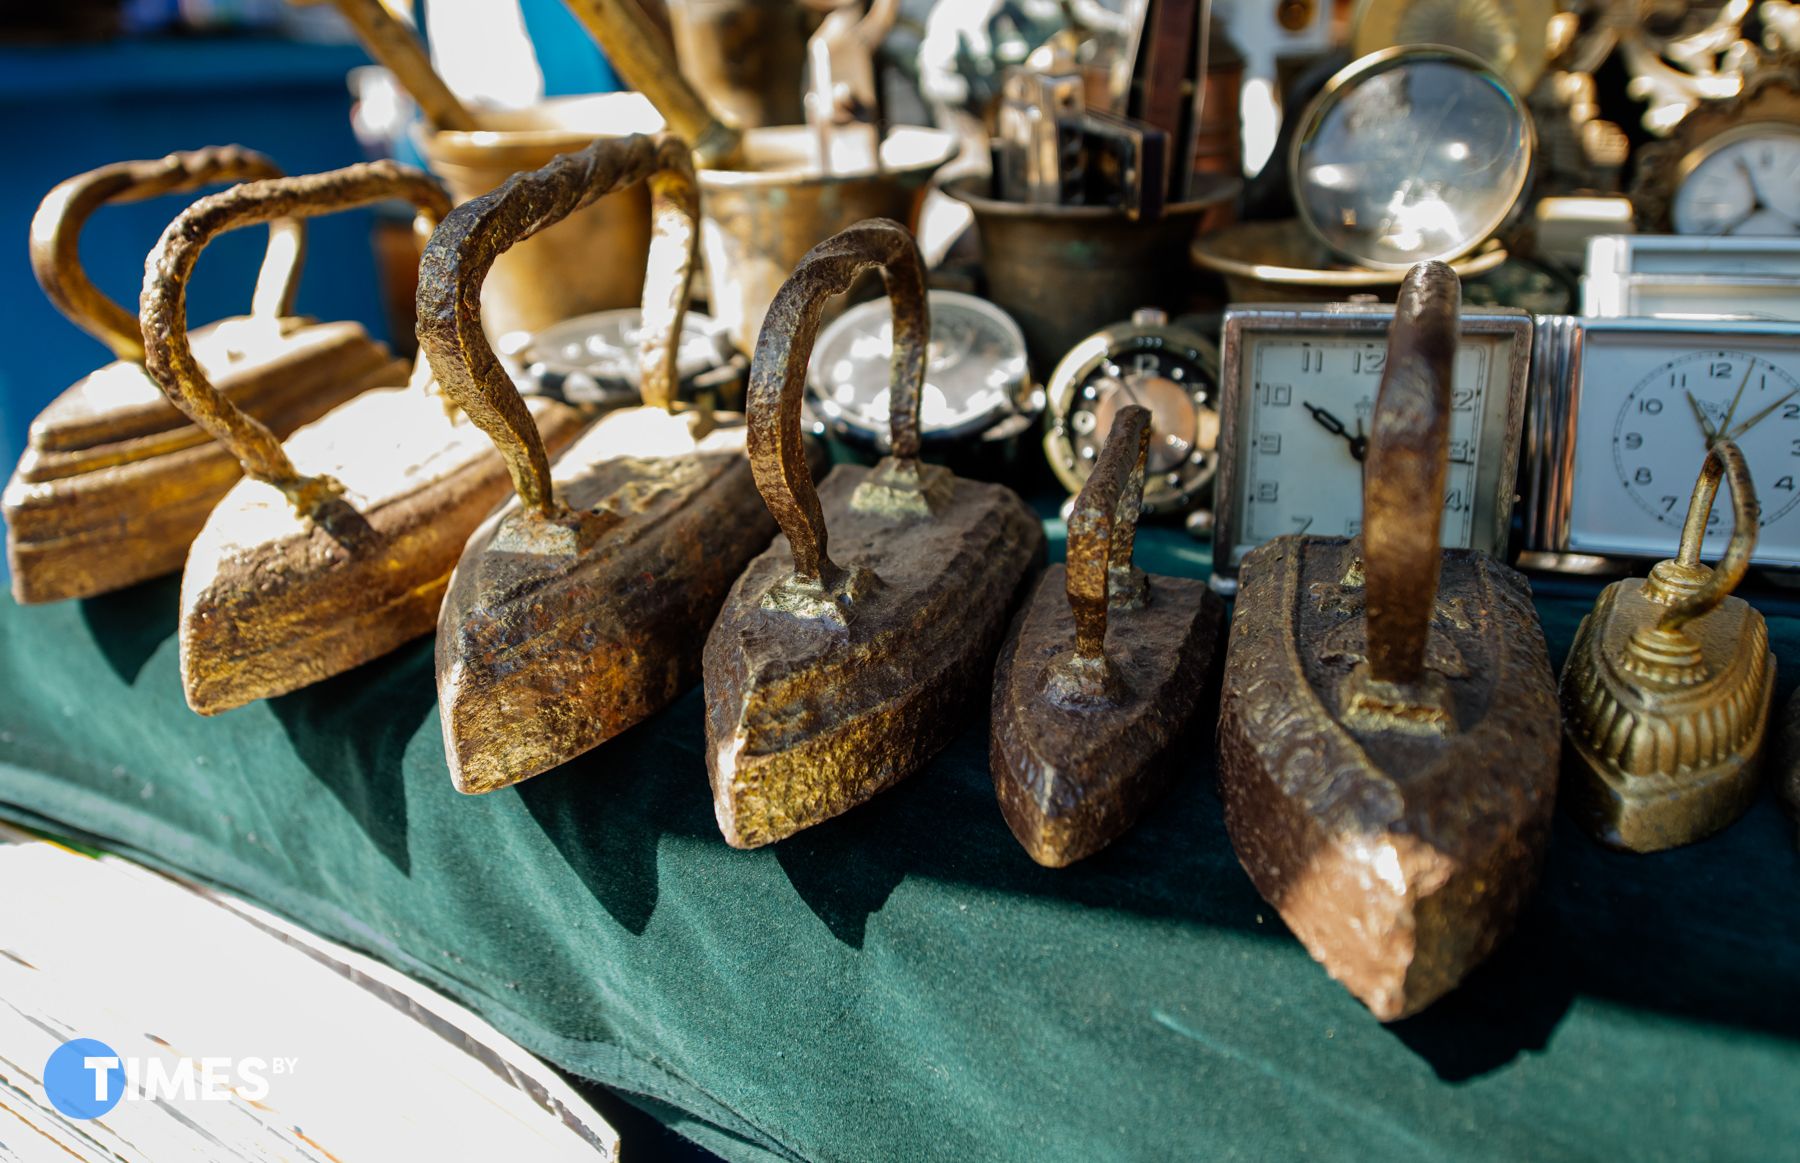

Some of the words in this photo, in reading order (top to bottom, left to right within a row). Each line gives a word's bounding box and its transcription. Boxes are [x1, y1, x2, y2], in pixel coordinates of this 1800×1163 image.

[1302, 350, 1323, 373] 11
[1353, 351, 1387, 374] 12
[1709, 362, 1732, 378] 12
[1670, 373, 1686, 388] 11
[1761, 374, 1766, 390] 1
[1262, 383, 1292, 406] 10
[1451, 388, 1474, 412] 2
[1639, 398, 1663, 415] 10
[1782, 403, 1800, 419] 2
[1259, 433, 1281, 455] 9
[1625, 432, 1643, 450] 9
[1634, 467, 1652, 485] 8
[1774, 475, 1795, 492] 4
[1661, 496, 1677, 512] 7
